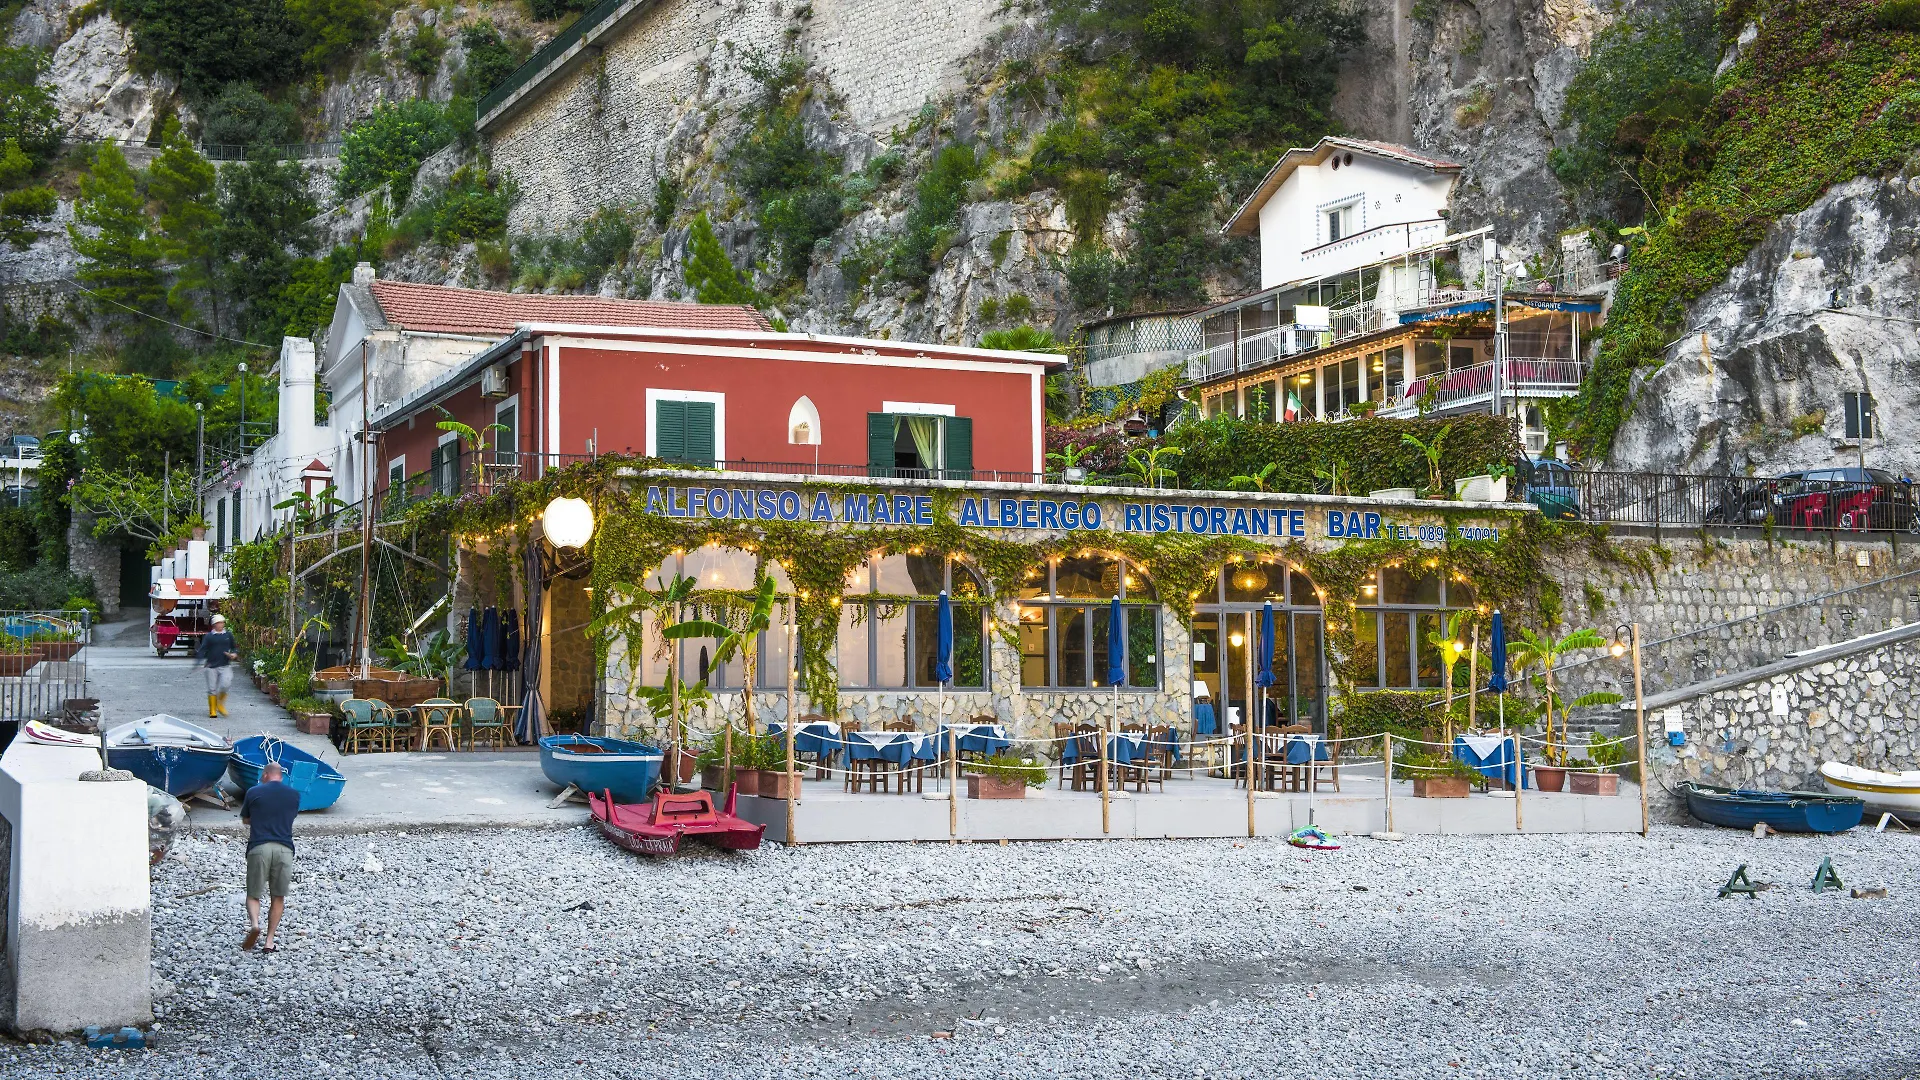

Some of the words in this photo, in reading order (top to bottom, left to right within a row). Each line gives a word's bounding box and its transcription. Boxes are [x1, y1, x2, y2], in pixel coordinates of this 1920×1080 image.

[1524, 300, 1561, 309] RISTORANTE
[644, 486, 801, 521] ALFONSO
[810, 492, 834, 522] A
[843, 493, 934, 525] MARE
[960, 498, 1101, 530] ALBERGO
[1124, 503, 1306, 537] RISTORANTE
[1327, 510, 1381, 539] BAR
[1450, 527, 1499, 543] 74091
